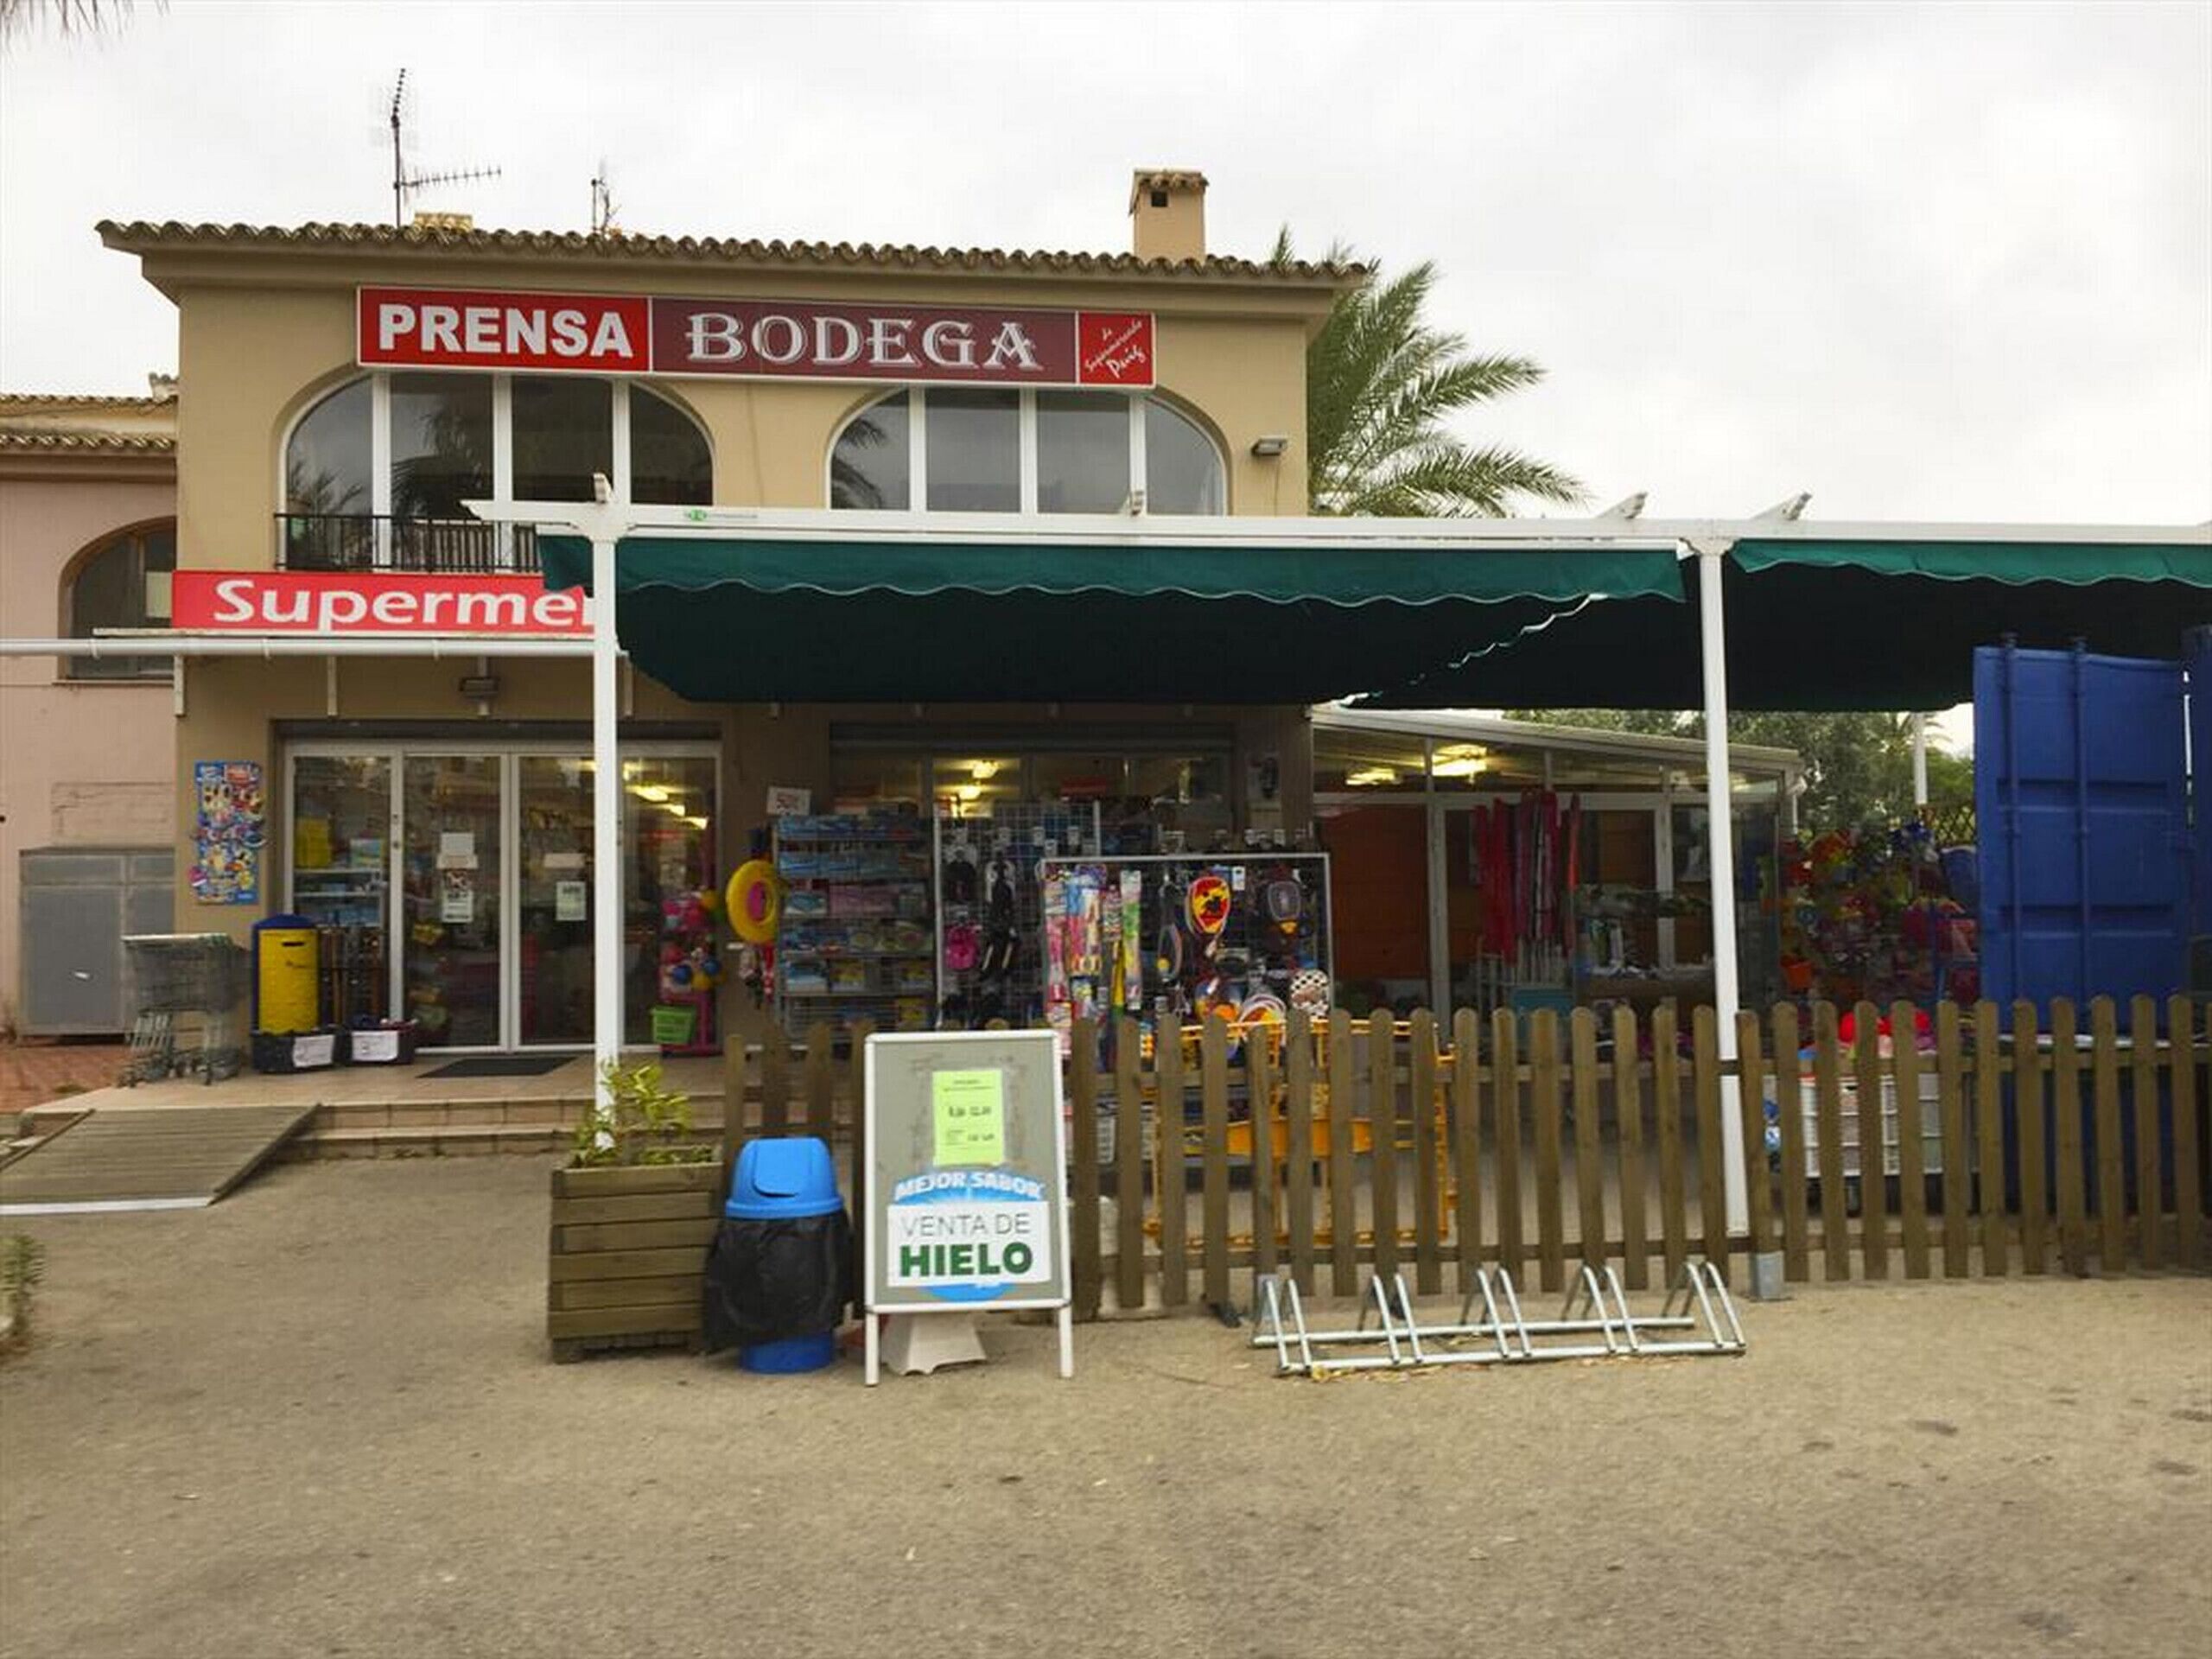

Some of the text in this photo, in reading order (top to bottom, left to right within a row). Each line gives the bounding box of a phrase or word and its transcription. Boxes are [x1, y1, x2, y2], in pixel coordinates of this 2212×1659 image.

[378, 303, 634, 359] PRENSA
[684, 312, 1043, 372] BODEGA
[901, 1212, 1031, 1237] VENTA DE
[899, 1242, 1033, 1277] HIELO
